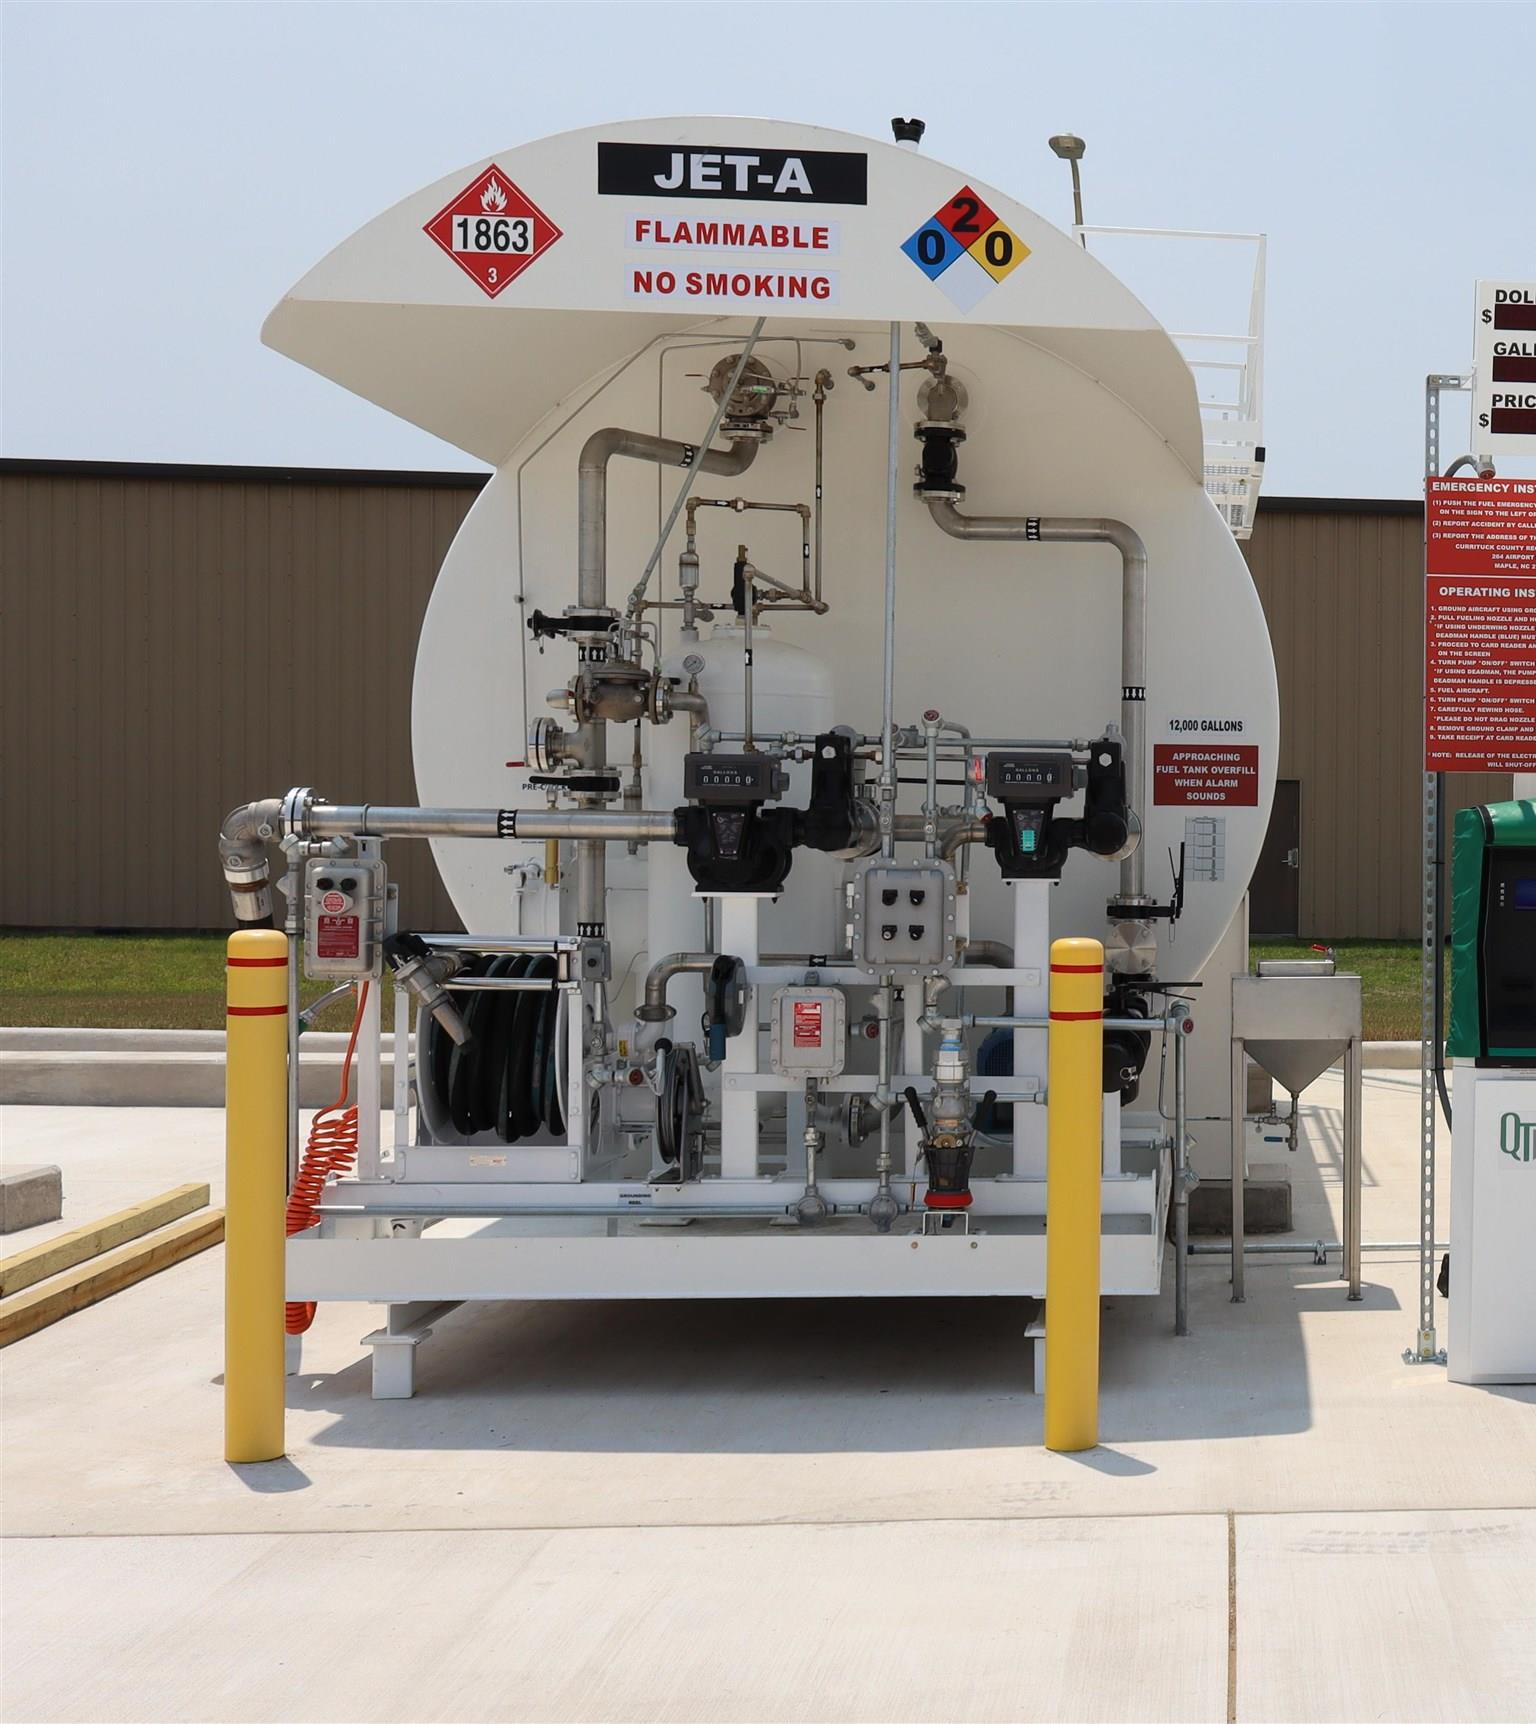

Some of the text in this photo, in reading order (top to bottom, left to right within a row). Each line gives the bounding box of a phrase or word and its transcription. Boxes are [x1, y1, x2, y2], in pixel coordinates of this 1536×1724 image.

[653, 152, 813, 195] JET-A
[951, 197, 980, 233] 2
[456, 217, 529, 252] 1863
[635, 220, 829, 249] FLAMMABLE
[917, 229, 946, 266] 0
[984, 230, 1013, 267] 0
[487, 267, 498, 284] 3
[633, 271, 830, 300] NO SMOKING
[1481, 309, 1492, 324] $
[1479, 413, 1489, 428] $
[1432, 482, 1508, 493] EMERGENCY
[1439, 587, 1509, 597] OPERATING
[1169, 720, 1243, 733] 12,000 GALLONS
[1172, 753, 1240, 761] APPROACHING
[1156, 765, 1256, 775] FUEL TANK OVERFILL
[1174, 779, 1238, 787] WHEN ALARM
[1186, 792, 1226, 801] SOUNDS
